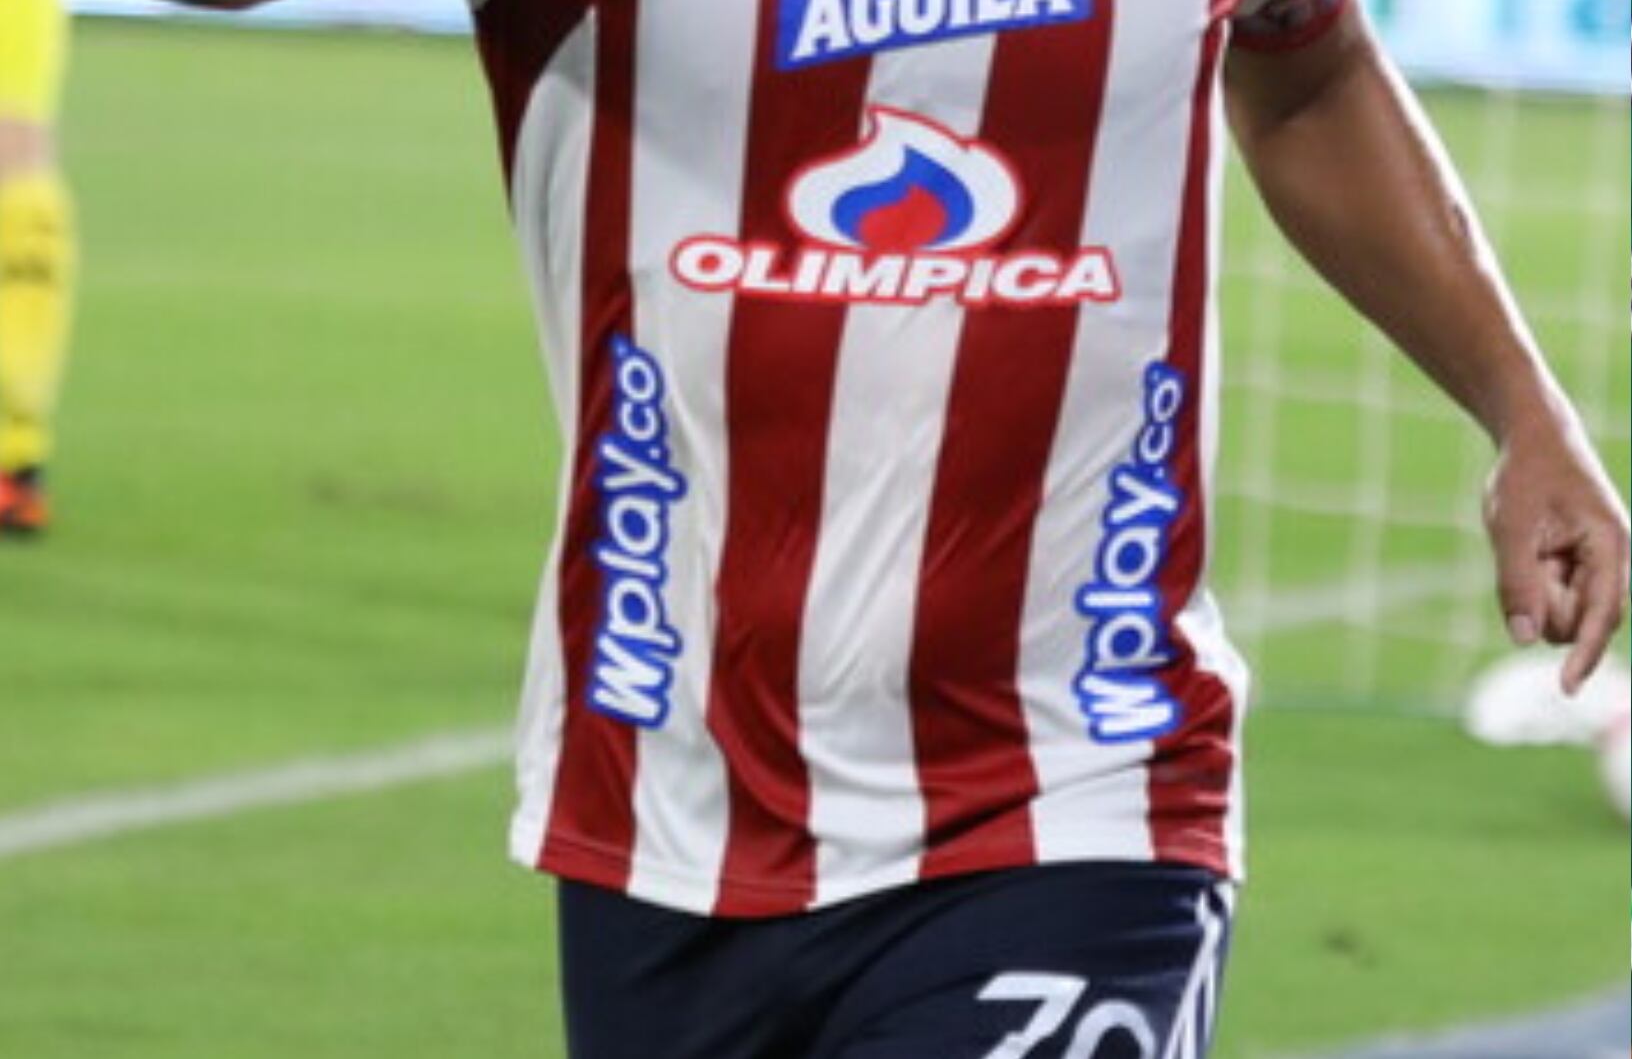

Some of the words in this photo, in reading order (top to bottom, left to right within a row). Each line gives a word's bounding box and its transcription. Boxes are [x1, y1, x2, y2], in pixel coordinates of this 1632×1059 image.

[672, 240, 1120, 302] OLIMPICA
[591, 340, 680, 722] Wplay.co
[1079, 367, 1182, 736] Wplay.co
